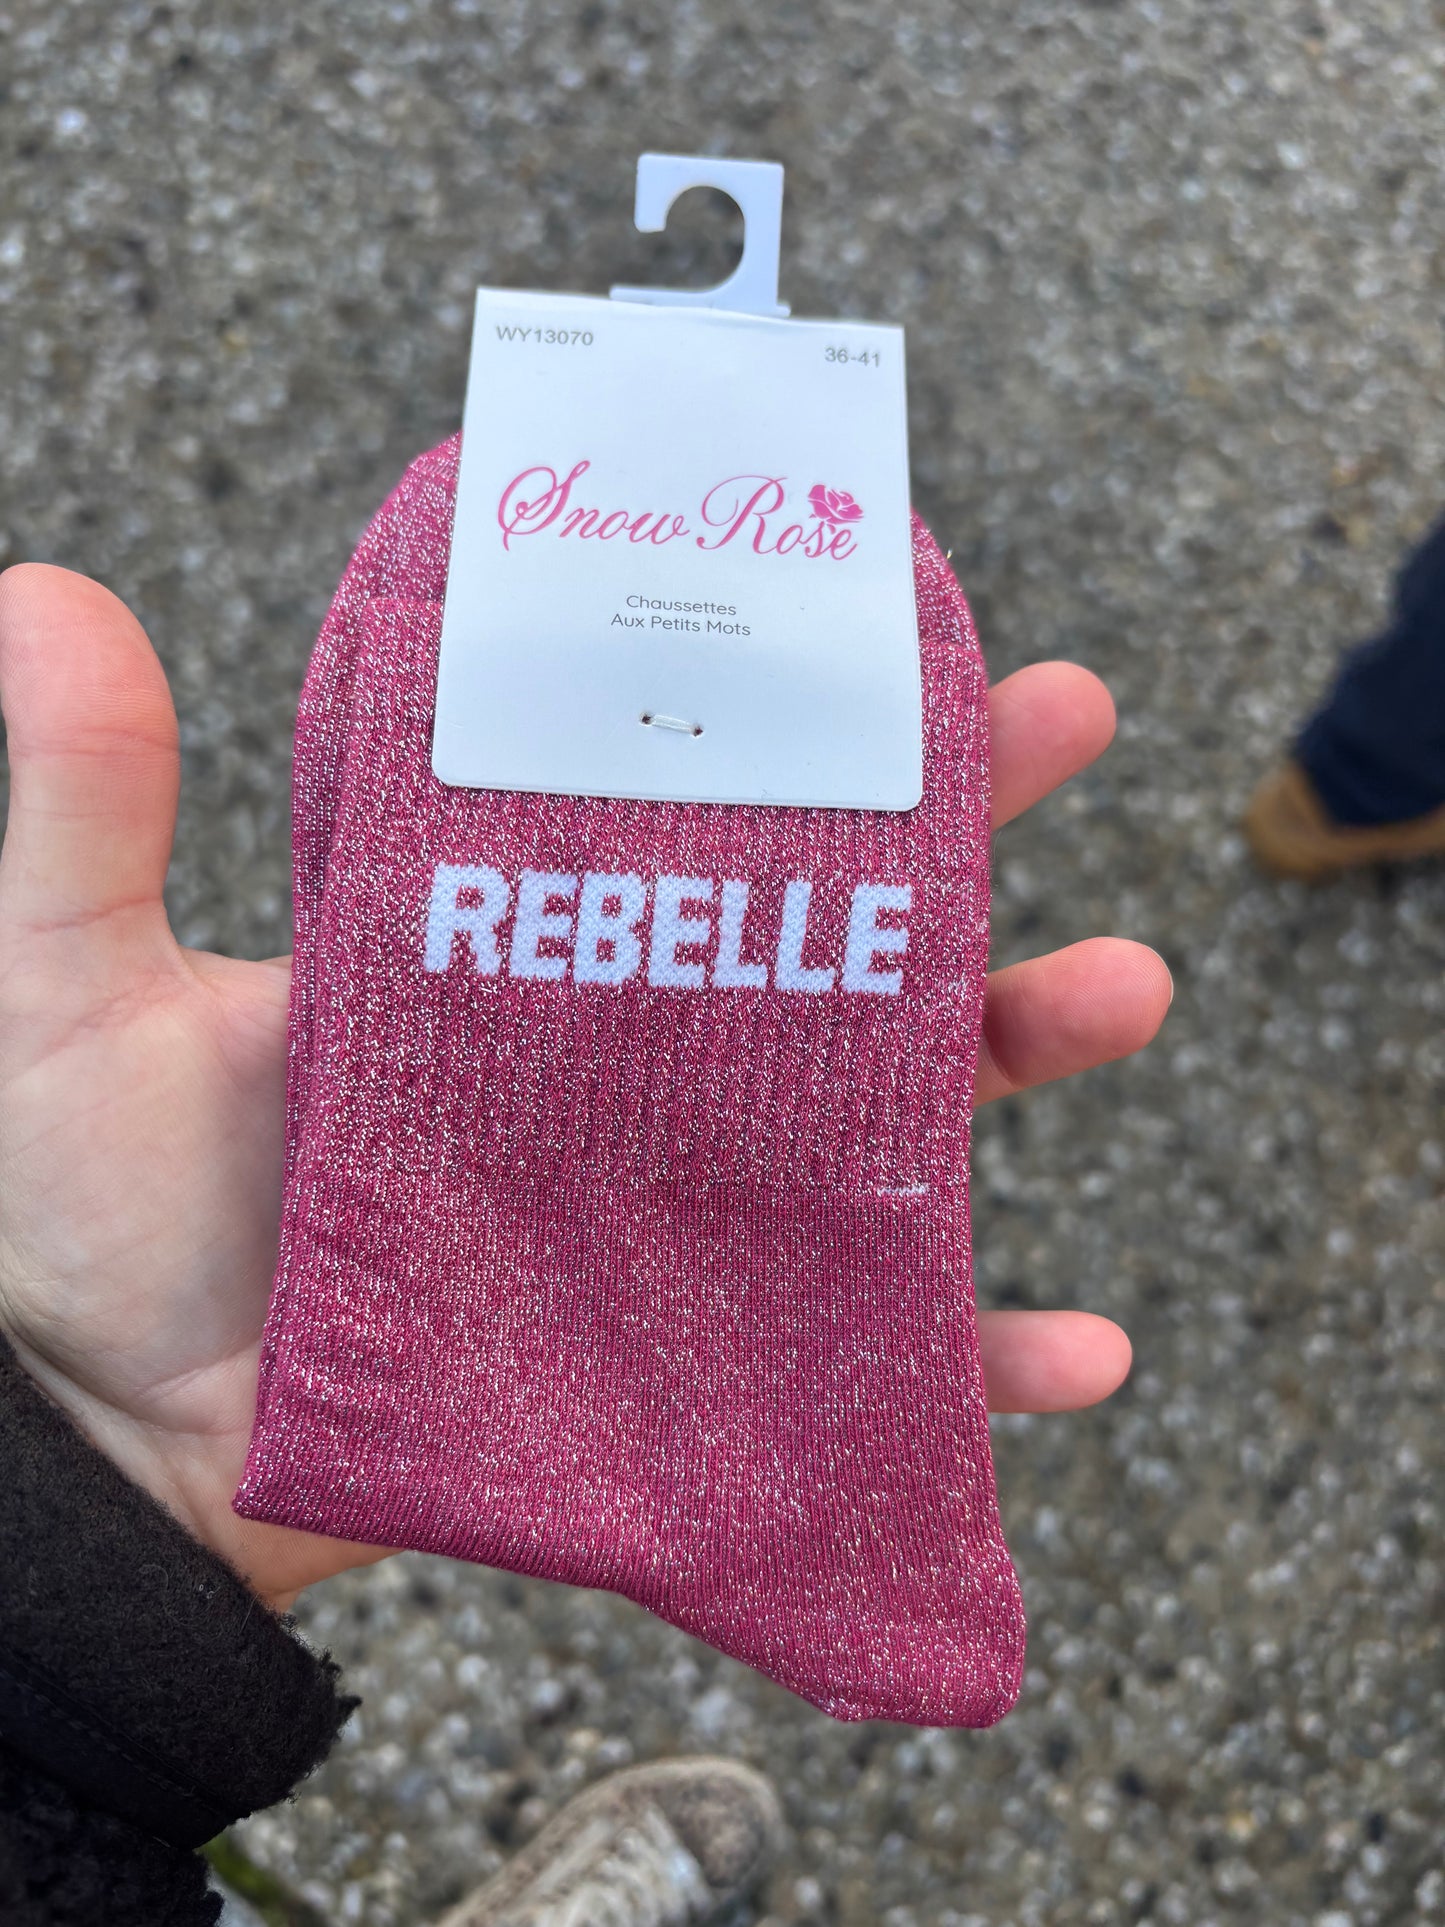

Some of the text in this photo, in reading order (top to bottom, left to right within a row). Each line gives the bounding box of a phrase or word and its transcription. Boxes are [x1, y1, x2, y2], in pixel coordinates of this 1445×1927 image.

[496, 326, 594, 347] WY13070
[824, 346, 882, 368] 36-41
[497, 460, 858, 561] Snow Rose
[626, 595, 737, 616] Chaussettes
[611, 614, 751, 636] Aux Petits Mots
[423, 862, 913, 996] REBELLE
